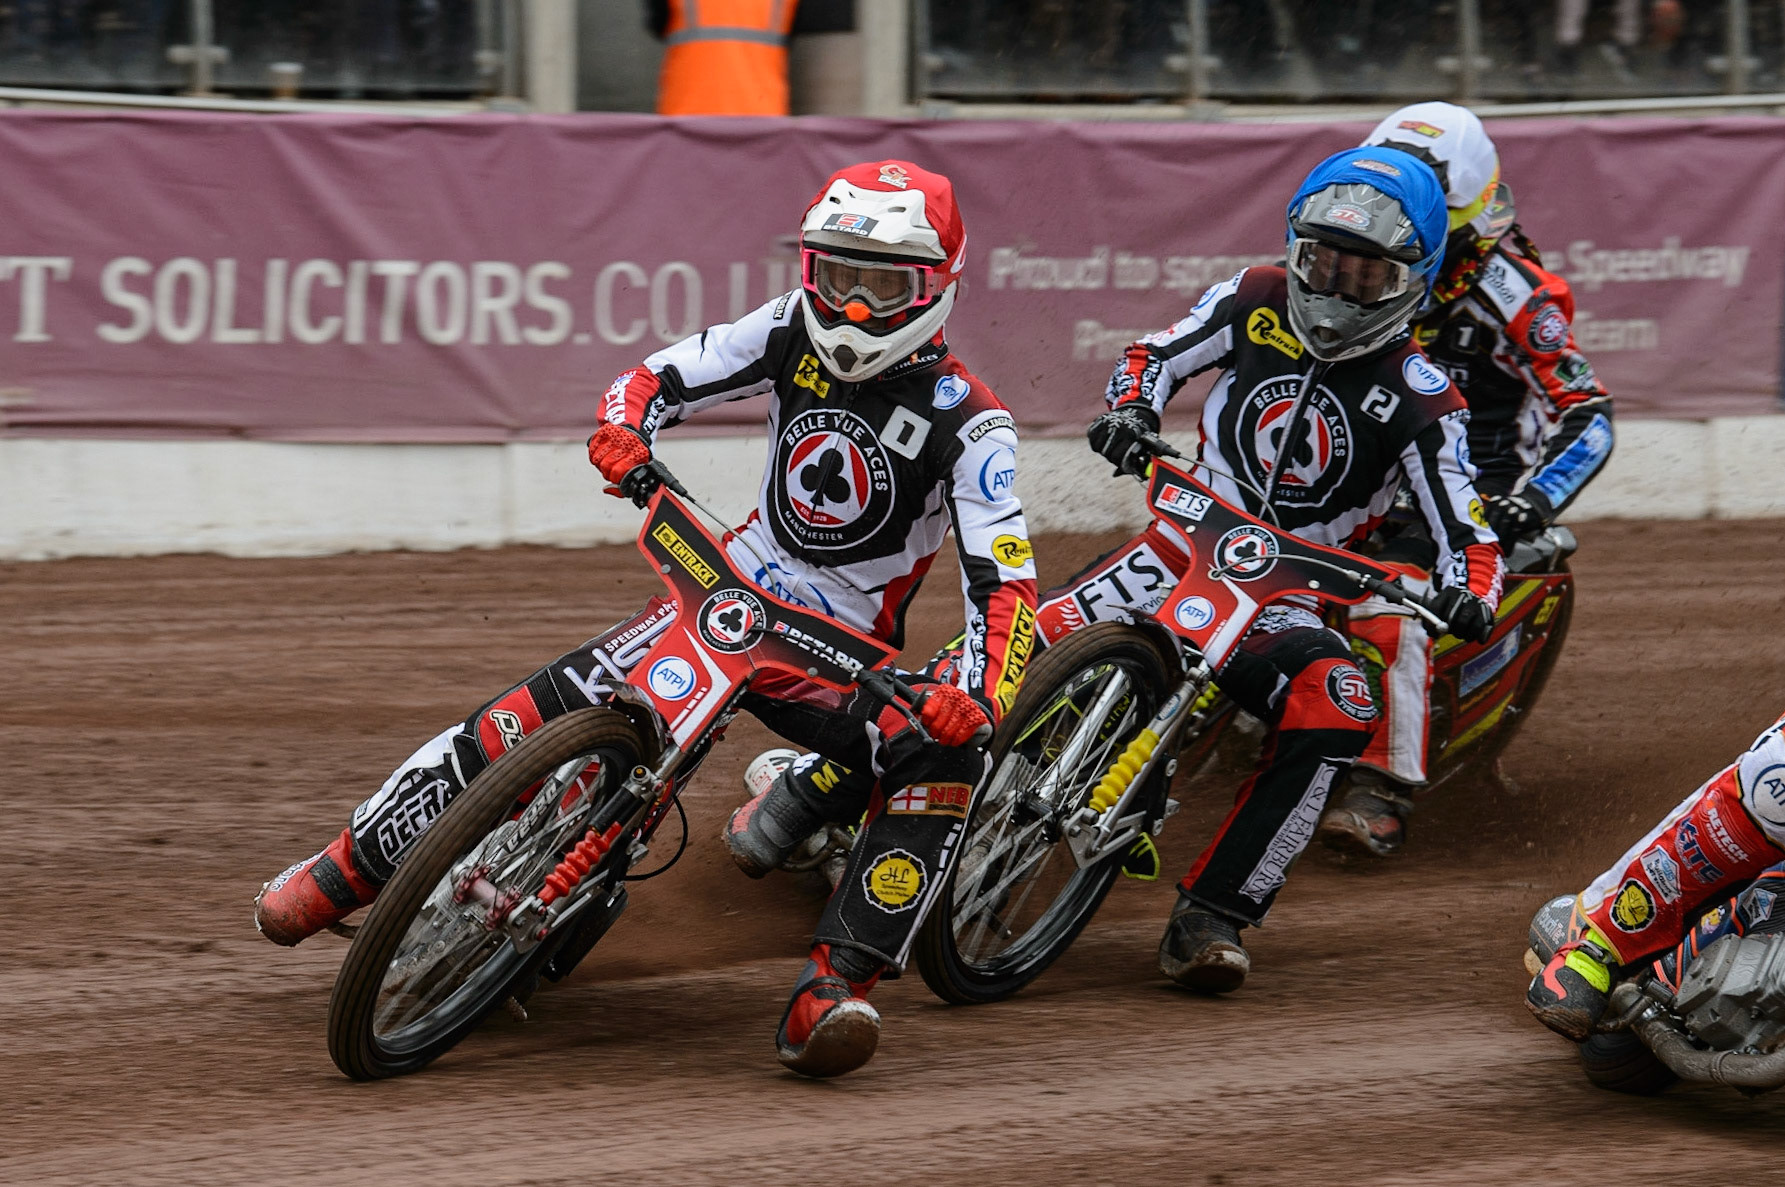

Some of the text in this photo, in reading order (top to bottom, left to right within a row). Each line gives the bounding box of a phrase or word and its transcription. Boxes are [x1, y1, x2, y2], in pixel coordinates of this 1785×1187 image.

[824, 223, 868, 236] BETARD
[1331, 208, 1364, 224] STS
[1566, 241, 1750, 292] Speedway
[1458, 326, 1474, 347] 1
[1253, 383, 1297, 410] BELLE
[1327, 415, 1346, 457] ACES
[1371, 387, 1394, 420] 2
[785, 415, 888, 492] BELLE VUE ACES
[1175, 490, 1209, 512] FTS
[1227, 528, 1251, 541] BELLE
[1267, 541, 1276, 555] ACE
[672, 540, 714, 583] ENTRACK
[1074, 550, 1164, 624] FTS
[713, 591, 763, 628] BELLE VUE ACE
[1183, 604, 1206, 621] ATPI
[604, 614, 658, 652] SPEEDWAY
[656, 667, 686, 690] ATPI
[1247, 768, 1335, 899] C & L FAIRBURN
